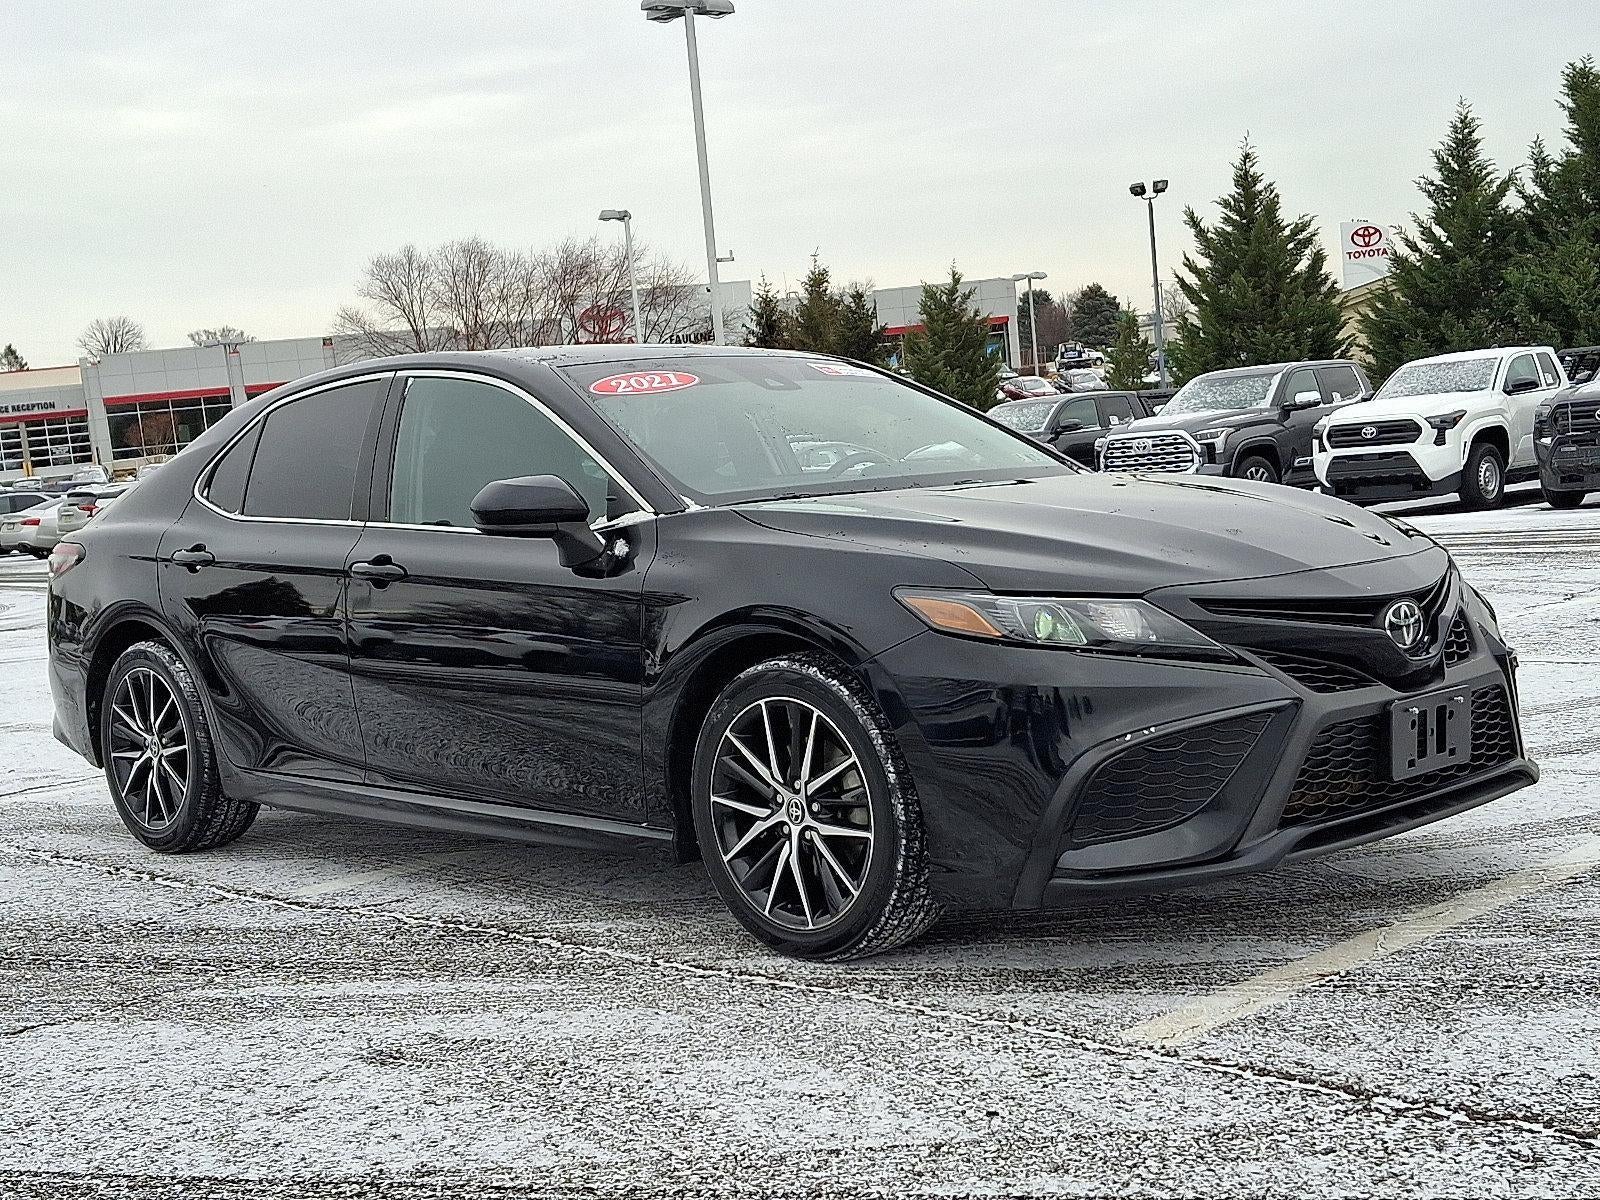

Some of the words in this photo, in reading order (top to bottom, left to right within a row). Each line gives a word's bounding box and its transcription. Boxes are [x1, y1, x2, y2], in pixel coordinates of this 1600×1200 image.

[1346, 248, 1388, 259] TOYOTA
[669, 331, 716, 344] FAULKNE
[610, 373, 683, 393] 2021
[11, 401, 56, 412] RECEPTION
